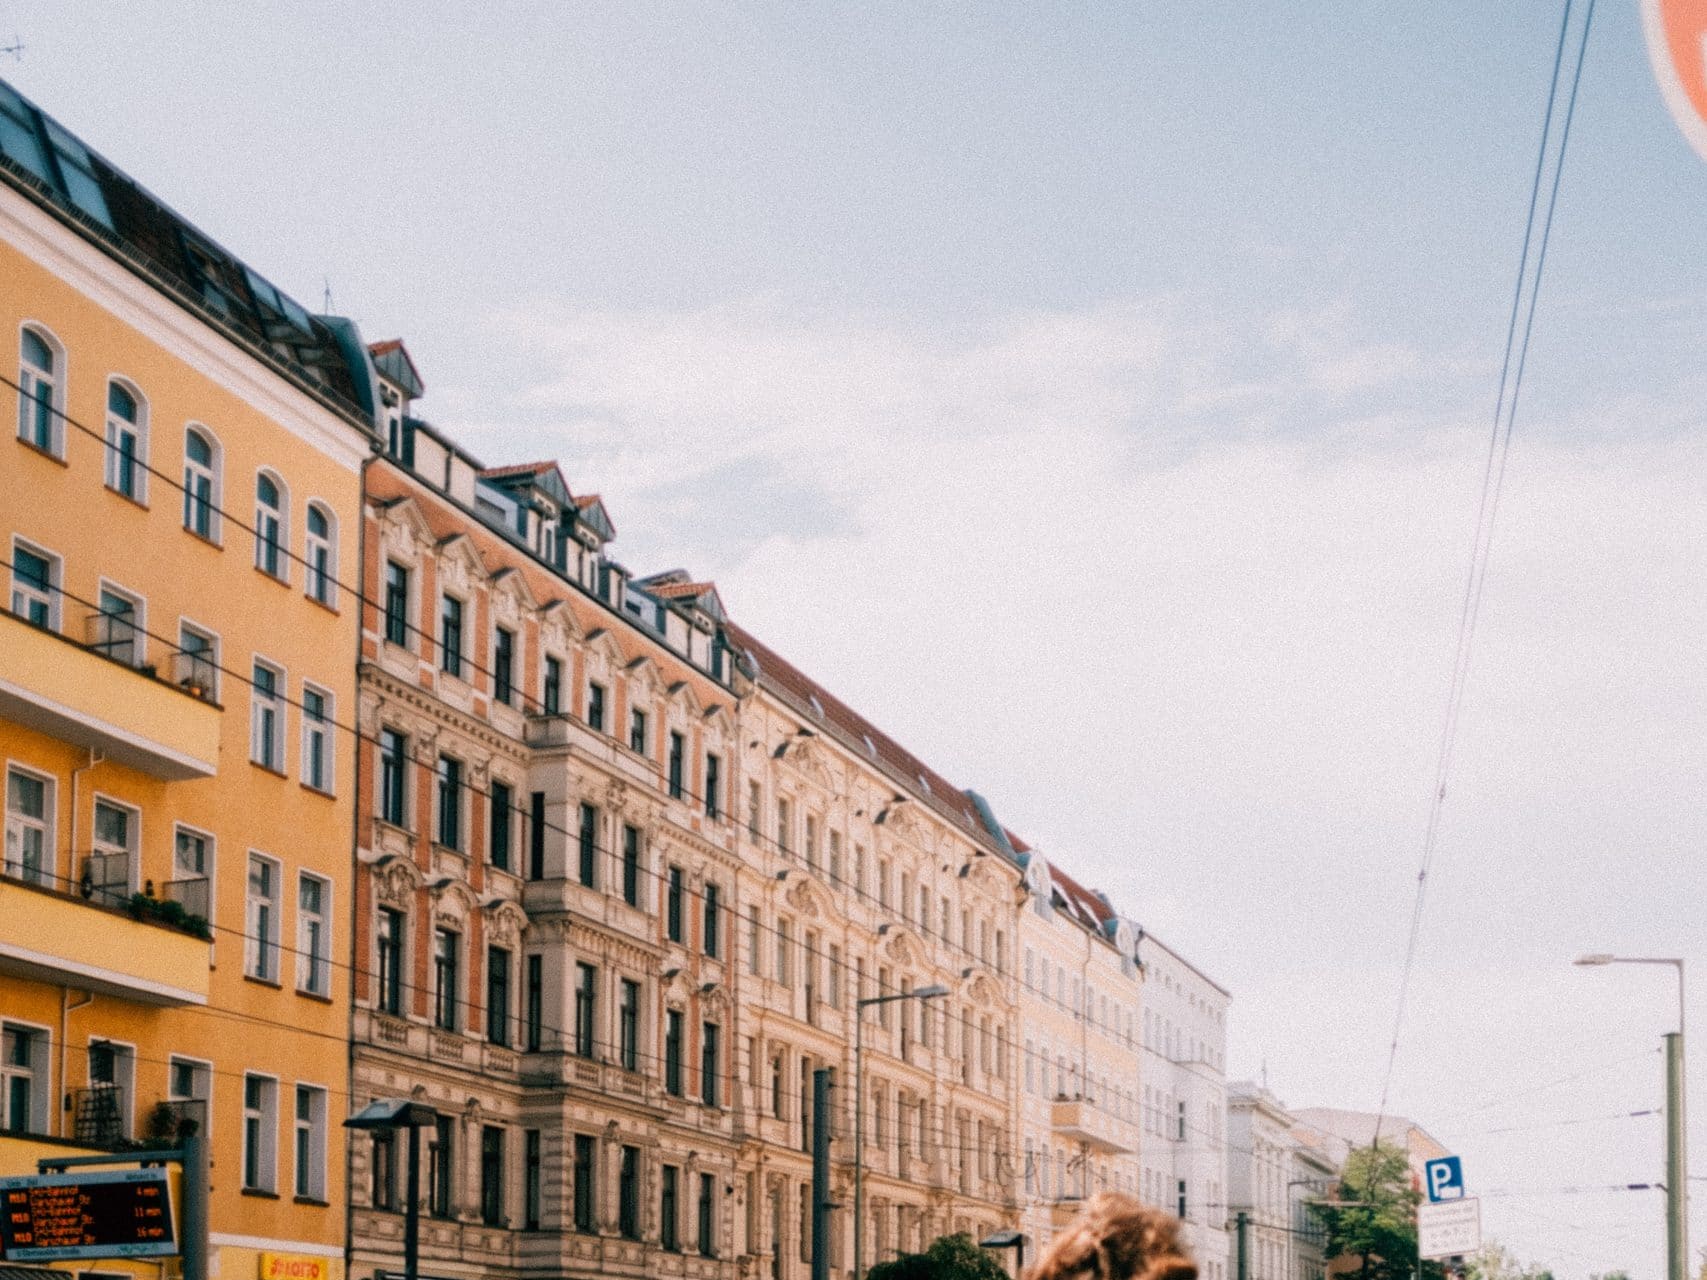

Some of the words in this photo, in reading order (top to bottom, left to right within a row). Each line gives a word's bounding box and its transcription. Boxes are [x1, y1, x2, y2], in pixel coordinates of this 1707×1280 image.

[1430, 1163, 1452, 1198] P
[14, 1232, 32, 1243] M10
[285, 1261, 320, 1279] LOTTO
